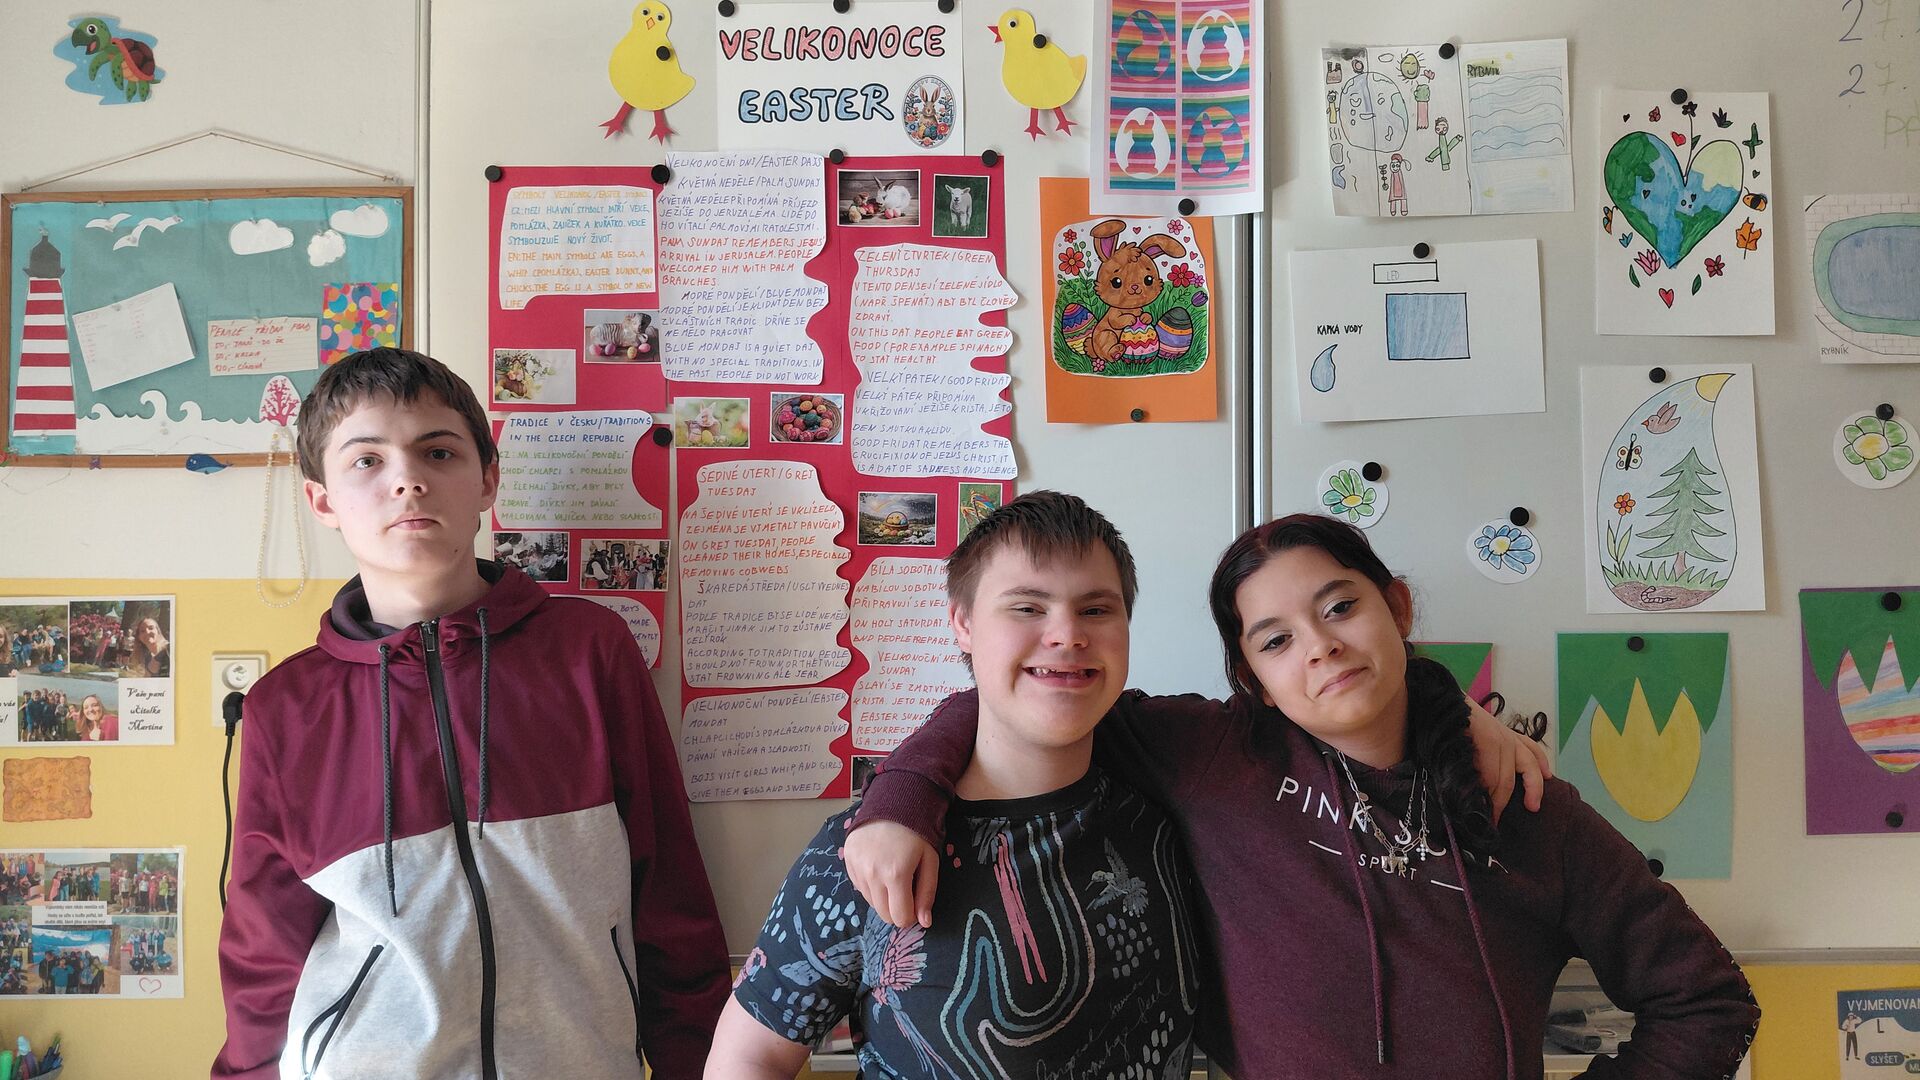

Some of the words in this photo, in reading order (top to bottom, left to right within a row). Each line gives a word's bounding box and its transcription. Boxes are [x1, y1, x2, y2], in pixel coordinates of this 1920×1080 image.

[719, 25, 946, 61] VELIKONOCE
[1467, 60, 1500, 77] RYBNÍK
[738, 83, 894, 123] EASTER
[700, 209, 711, 217] DO
[509, 236, 559, 245] SYMBOLIZUJE
[567, 233, 587, 244] NOVÝ
[591, 232, 612, 243] ŽIVOT.
[732, 238, 795, 247] REMEMBERS
[567, 252, 597, 260] SYMBOLS
[601, 251, 613, 259] ARE
[660, 253, 700, 262] ARRIVAL
[778, 250, 813, 258] PEOPLE
[586, 268, 610, 276] EASTER
[660, 264, 717, 273] WELCOMED
[722, 265, 738, 273] HIM
[743, 264, 766, 272] WITH
[770, 264, 795, 272] PALM
[1386, 271, 1399, 281] LED
[863, 282, 891, 292] TENTO
[807, 299, 825, 307] BEZ
[851, 328, 866, 337] ON
[869, 328, 888, 337] THIS
[915, 329, 953, 338] PEOPLE
[956, 329, 974, 338] EAT
[977, 331, 1010, 339] GREEN
[1317, 325, 1340, 335] KAPKA
[1345, 324, 1363, 334] VODY
[665, 342, 694, 353] BLUE
[854, 342, 881, 350] FOOD
[1821, 344, 1849, 355] RYBNÍK
[692, 358, 706, 366] NO
[665, 370, 684, 378] THE
[717, 371, 752, 379] PEOPLE
[775, 372, 791, 380] NOT
[794, 372, 819, 380] WORK
[510, 418, 548, 428] TRADICE
[853, 424, 876, 432] DEN
[583, 435, 624, 443] REPUBLIC
[853, 438, 880, 447] GOOD
[853, 451, 918, 460] CRUCIFIXION
[920, 452, 932, 460] OF
[963, 466, 980, 474] AND
[983, 466, 1017, 475] SILENCE
[684, 510, 698, 520] NA
[777, 506, 789, 515] SE
[683, 540, 698, 551] ON
[781, 536, 816, 547] PEOPLE
[683, 553, 728, 563] CLEANED
[733, 549, 761, 561] THEIR
[682, 568, 735, 579] REMOVING
[739, 566, 789, 576] COBWEBS
[914, 600, 926, 608] SE
[686, 612, 718, 622] PODLE
[723, 611, 764, 622] TRADICE
[854, 619, 868, 628] ON
[760, 625, 776, 633] JIM
[779, 625, 789, 633] TO
[688, 649, 744, 658] ACCORDING
[687, 660, 727, 671] SHOULD
[717, 671, 770, 682] FROWNING
[861, 712, 898, 722] EASTER
[128, 720, 163, 731] Martina
[744, 767, 768, 778] GIRLS
[800, 762, 816, 771] AND
[691, 790, 712, 800] GIVE
[715, 789, 740, 797] THEM
[1877, 1019, 1885, 1033] L
[1870, 1054, 1898, 1064] SLYŠET
